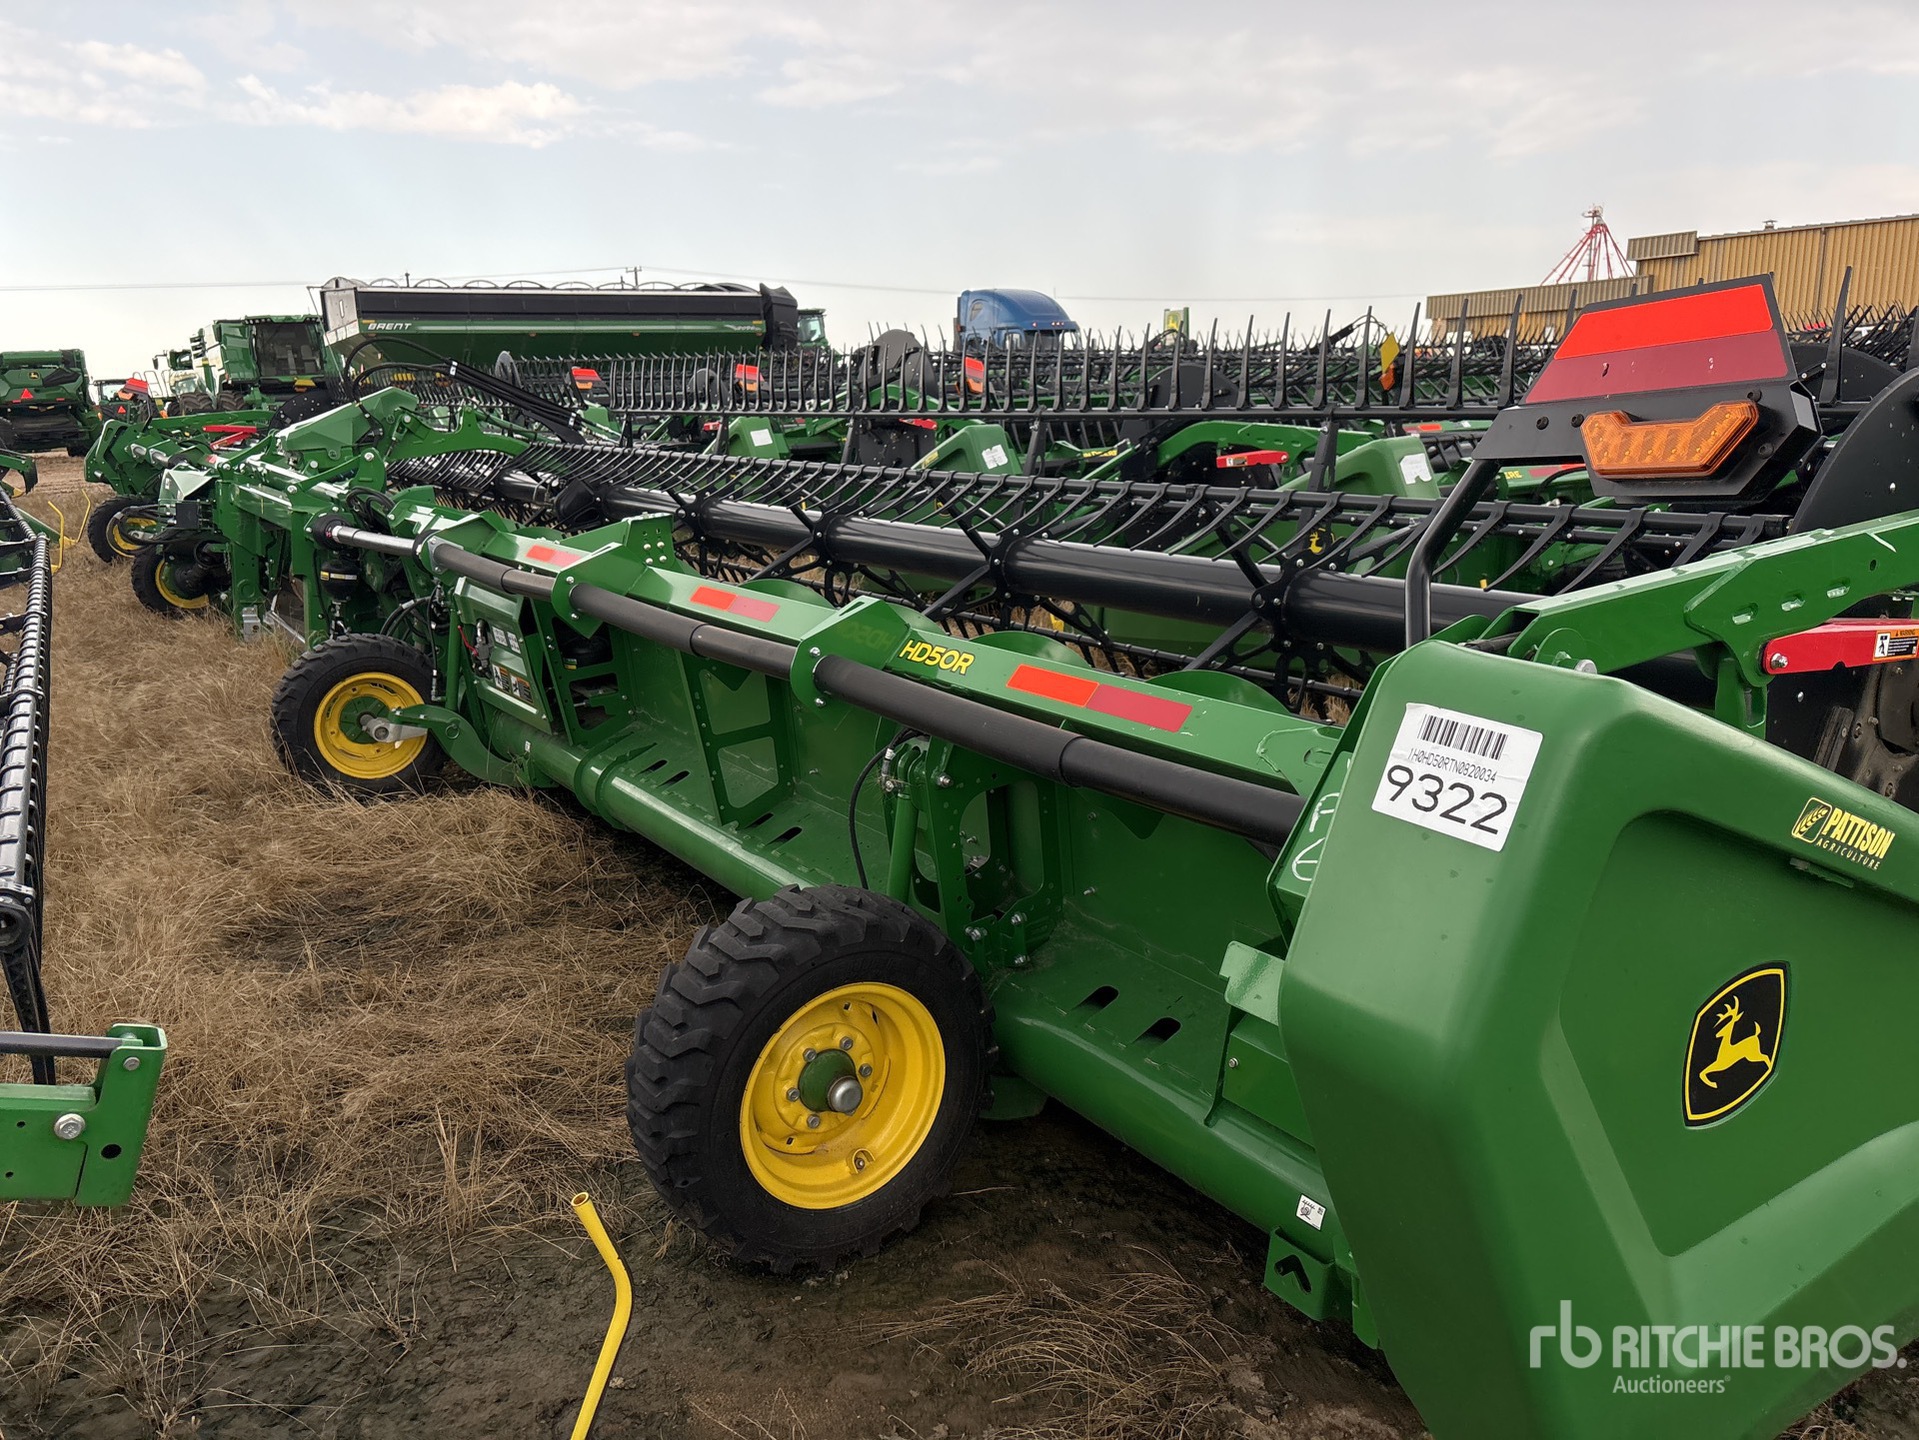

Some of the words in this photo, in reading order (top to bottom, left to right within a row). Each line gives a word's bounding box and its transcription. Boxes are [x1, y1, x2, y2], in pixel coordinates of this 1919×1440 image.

[368, 322, 412, 330] BRENT
[898, 639, 976, 675] HD50R
[1387, 764, 1507, 835] 9322
[1821, 807, 1896, 859] PATTISON
[1816, 838, 1881, 870] AGRICULTURE
